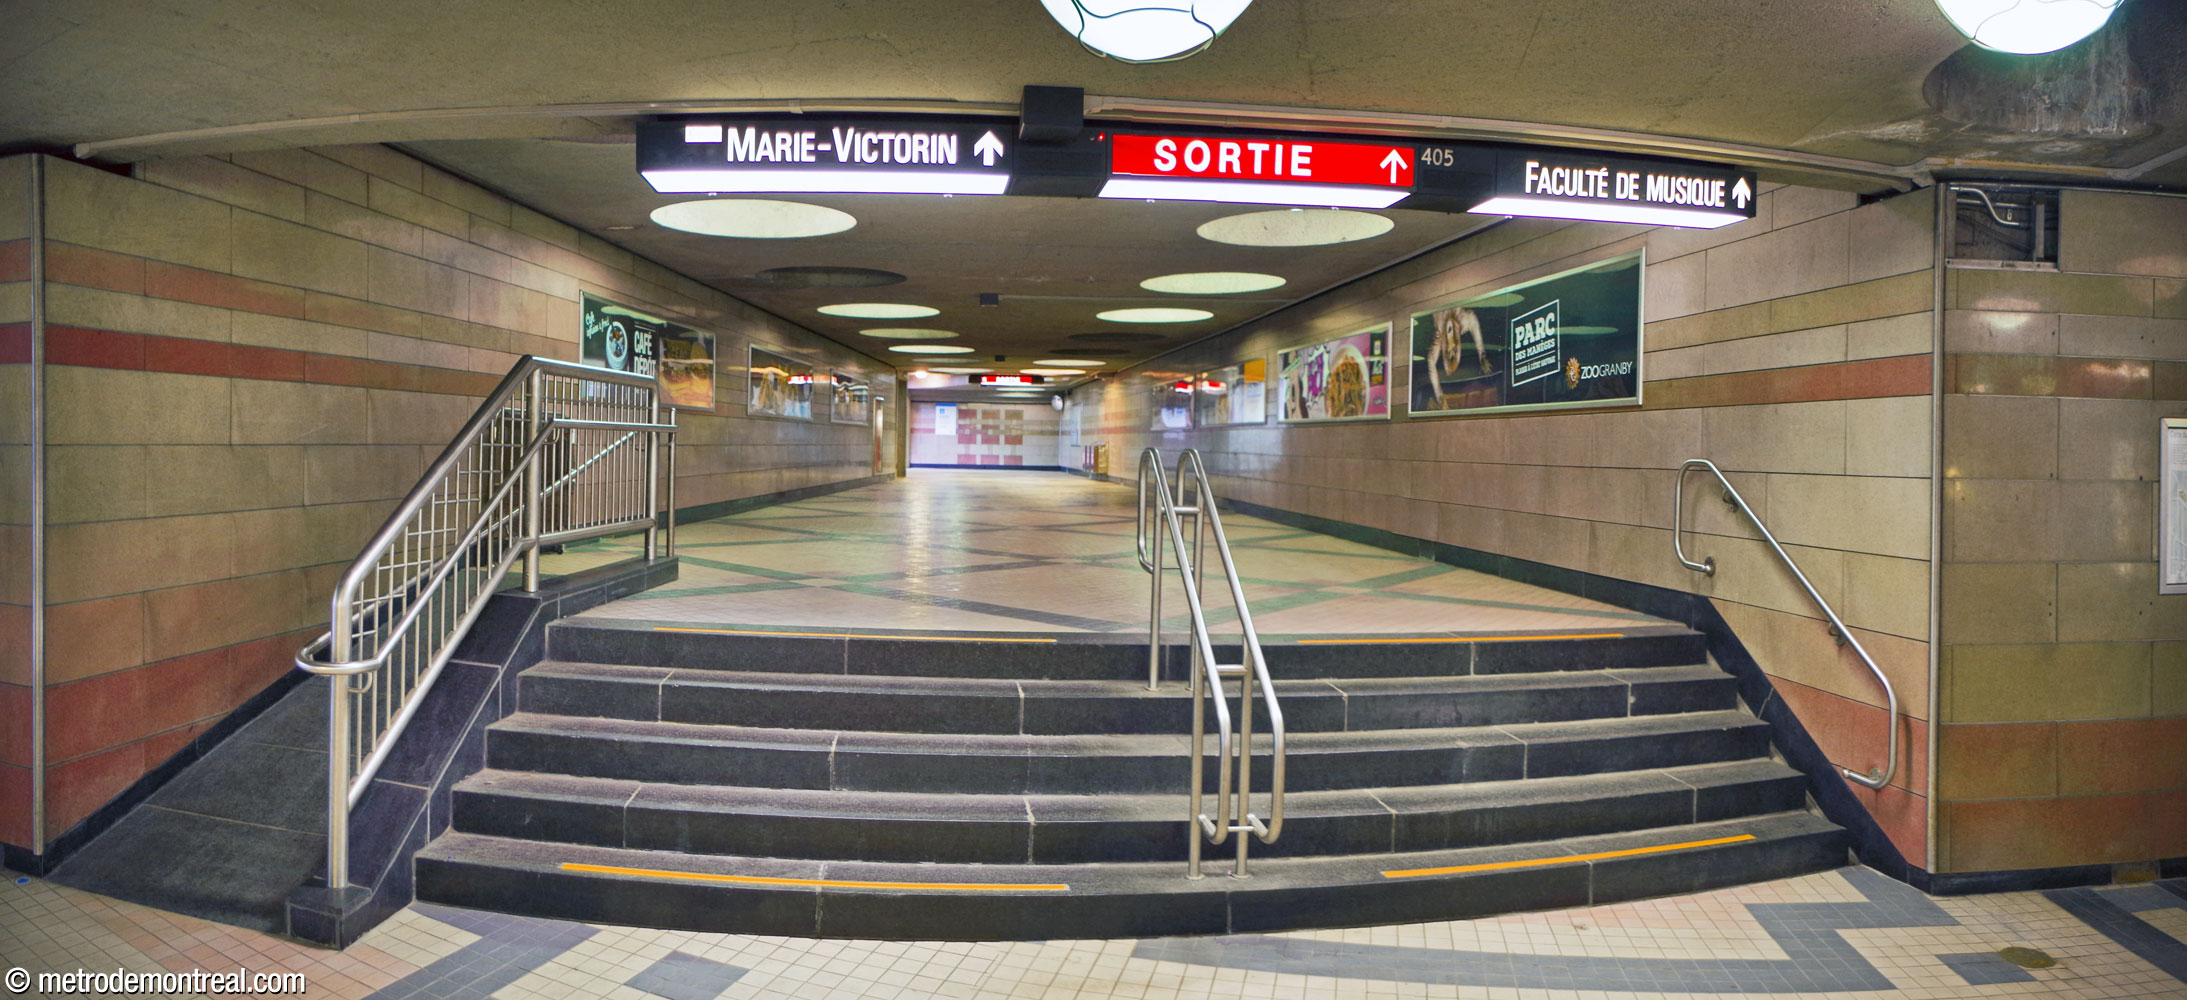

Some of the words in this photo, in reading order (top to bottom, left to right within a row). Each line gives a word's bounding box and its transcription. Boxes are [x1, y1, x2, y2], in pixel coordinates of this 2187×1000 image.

[727, 126, 957, 164] MARIE-VICTORIN
[1153, 139, 1313, 177] SORTIE
[1421, 148, 1454, 167] 405
[1525, 160, 1609, 198] FACULTÉ
[1615, 171, 1640, 201] DE
[1646, 174, 1726, 208] MUSIQUE
[633, 330, 653, 356] CAFÉ
[1515, 312, 1555, 349] PARC
[1515, 350, 1526, 361] DES
